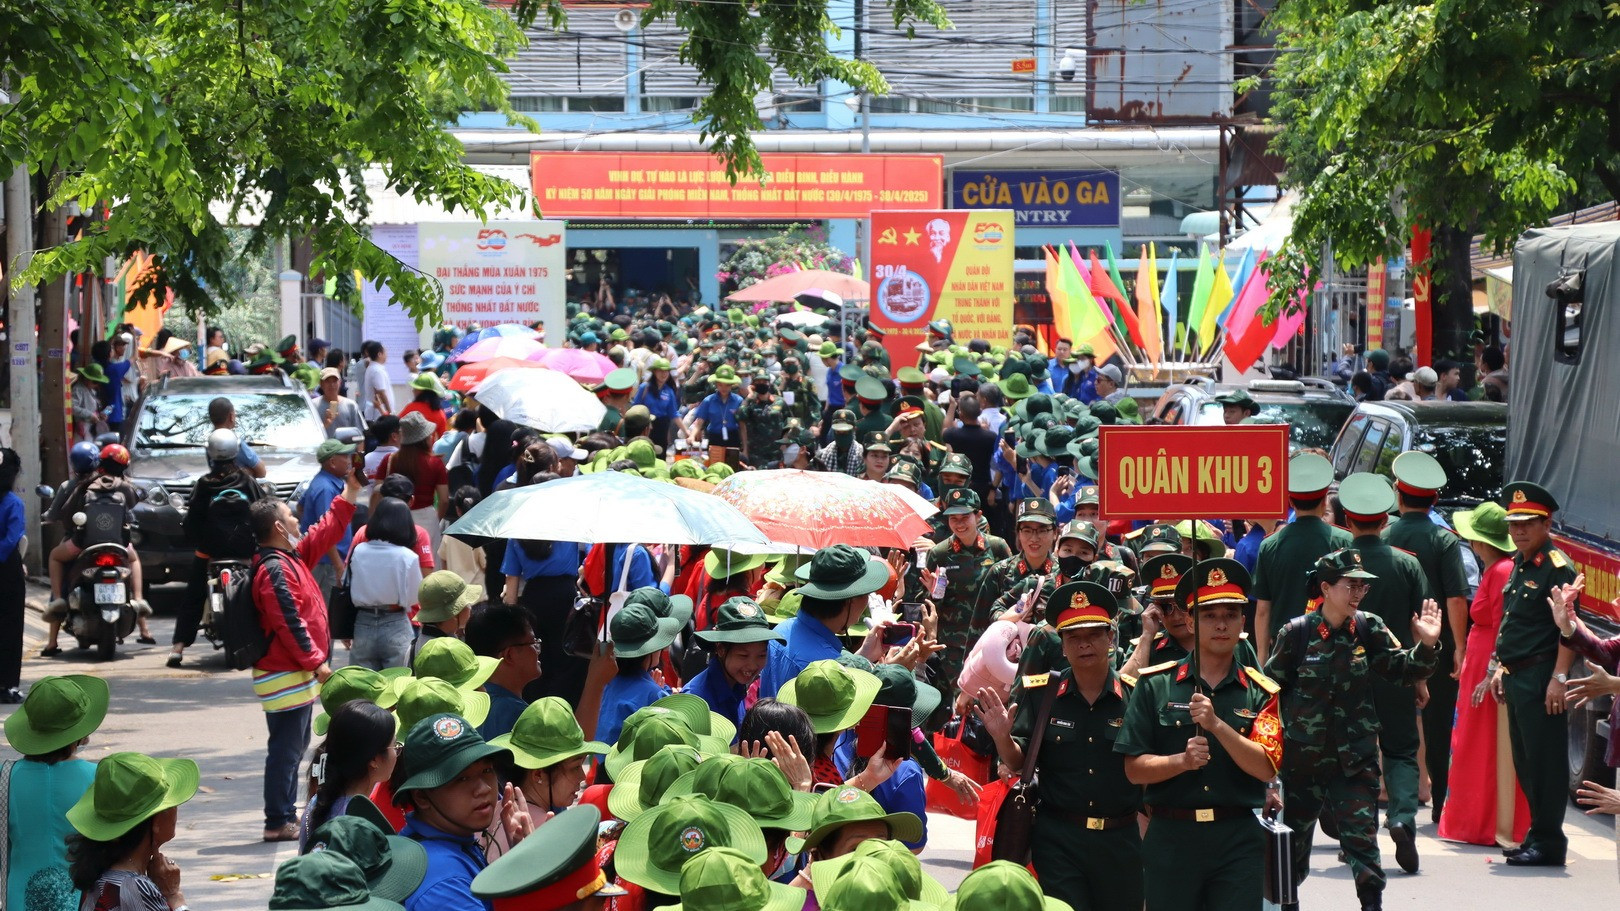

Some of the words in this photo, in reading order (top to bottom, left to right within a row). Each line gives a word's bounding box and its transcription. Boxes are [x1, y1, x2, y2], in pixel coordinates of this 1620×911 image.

[609, 170, 628, 183] VINH
[659, 169, 675, 183] HÀO
[677, 169, 688, 183] LÀ
[689, 169, 705, 184] LỰC
[797, 171, 818, 184] BINH,
[841, 170, 863, 183] HÀNH
[558, 186, 579, 201] NIỆM
[581, 188, 593, 200] 50
[594, 186, 613, 200] NĂM
[614, 186, 636, 200] NGÀY
[638, 186, 656, 200] GIẢI
[657, 186, 686, 200] PHÓNG
[687, 186, 708, 200] MIỀN
[709, 188, 730, 202] NAM,
[732, 185, 759, 201] THỐNG
[761, 186, 782, 201] NHẤT
[783, 186, 800, 201] ĐẤT
[802, 188, 825, 202] NƯỚC
[826, 190, 872, 202] (30/4/1975
[879, 190, 928, 202] 30/4/2025)
[962, 174, 1013, 205] CỬA
[1020, 176, 1069, 205] VÀO
[1076, 181, 1110, 204] GA
[1014, 210, 1071, 222] NTRY
[436, 267, 450, 279] ĐẠI
[453, 264, 480, 278] THẮNG
[482, 265, 500, 278] MÙA
[503, 264, 526, 278] XUÂN
[529, 267, 548, 278] 1975
[875, 264, 907, 278] 30/4
[966, 265, 980, 276] QUÂN
[449, 283, 466, 295] SỨC
[468, 284, 493, 298] MẠNH
[495, 281, 512, 295] CỦA
[514, 282, 520, 295] Ý
[522, 282, 536, 295] CHÍ
[951, 281, 966, 291] NHÂN
[967, 281, 979, 291] DÂN
[980, 281, 991, 292] VIỆT
[992, 282, 1004, 291] NAM
[445, 299, 473, 312] THỐNG
[475, 299, 497, 312] NHẤT
[499, 299, 514, 312] ĐẤT
[517, 300, 540, 312] NƯỚC
[955, 298, 972, 307] TRUNG
[973, 296, 990, 307] THÀNH
[991, 297, 1000, 307] VỚI
[952, 311, 959, 323] TỔ
[960, 311, 976, 324] QUỐC,
[977, 312, 986, 323] VỚI
[987, 311, 1002, 323] ĐẢNG,
[957, 329, 972, 339] NƯỚC
[973, 329, 980, 339] VÀ
[981, 329, 997, 339] NHÂN
[997, 329, 1009, 339] DÂN
[1119, 448, 1189, 498] QUÂN
[1198, 456, 1248, 493] KHU
[1257, 456, 1272, 494] 3
